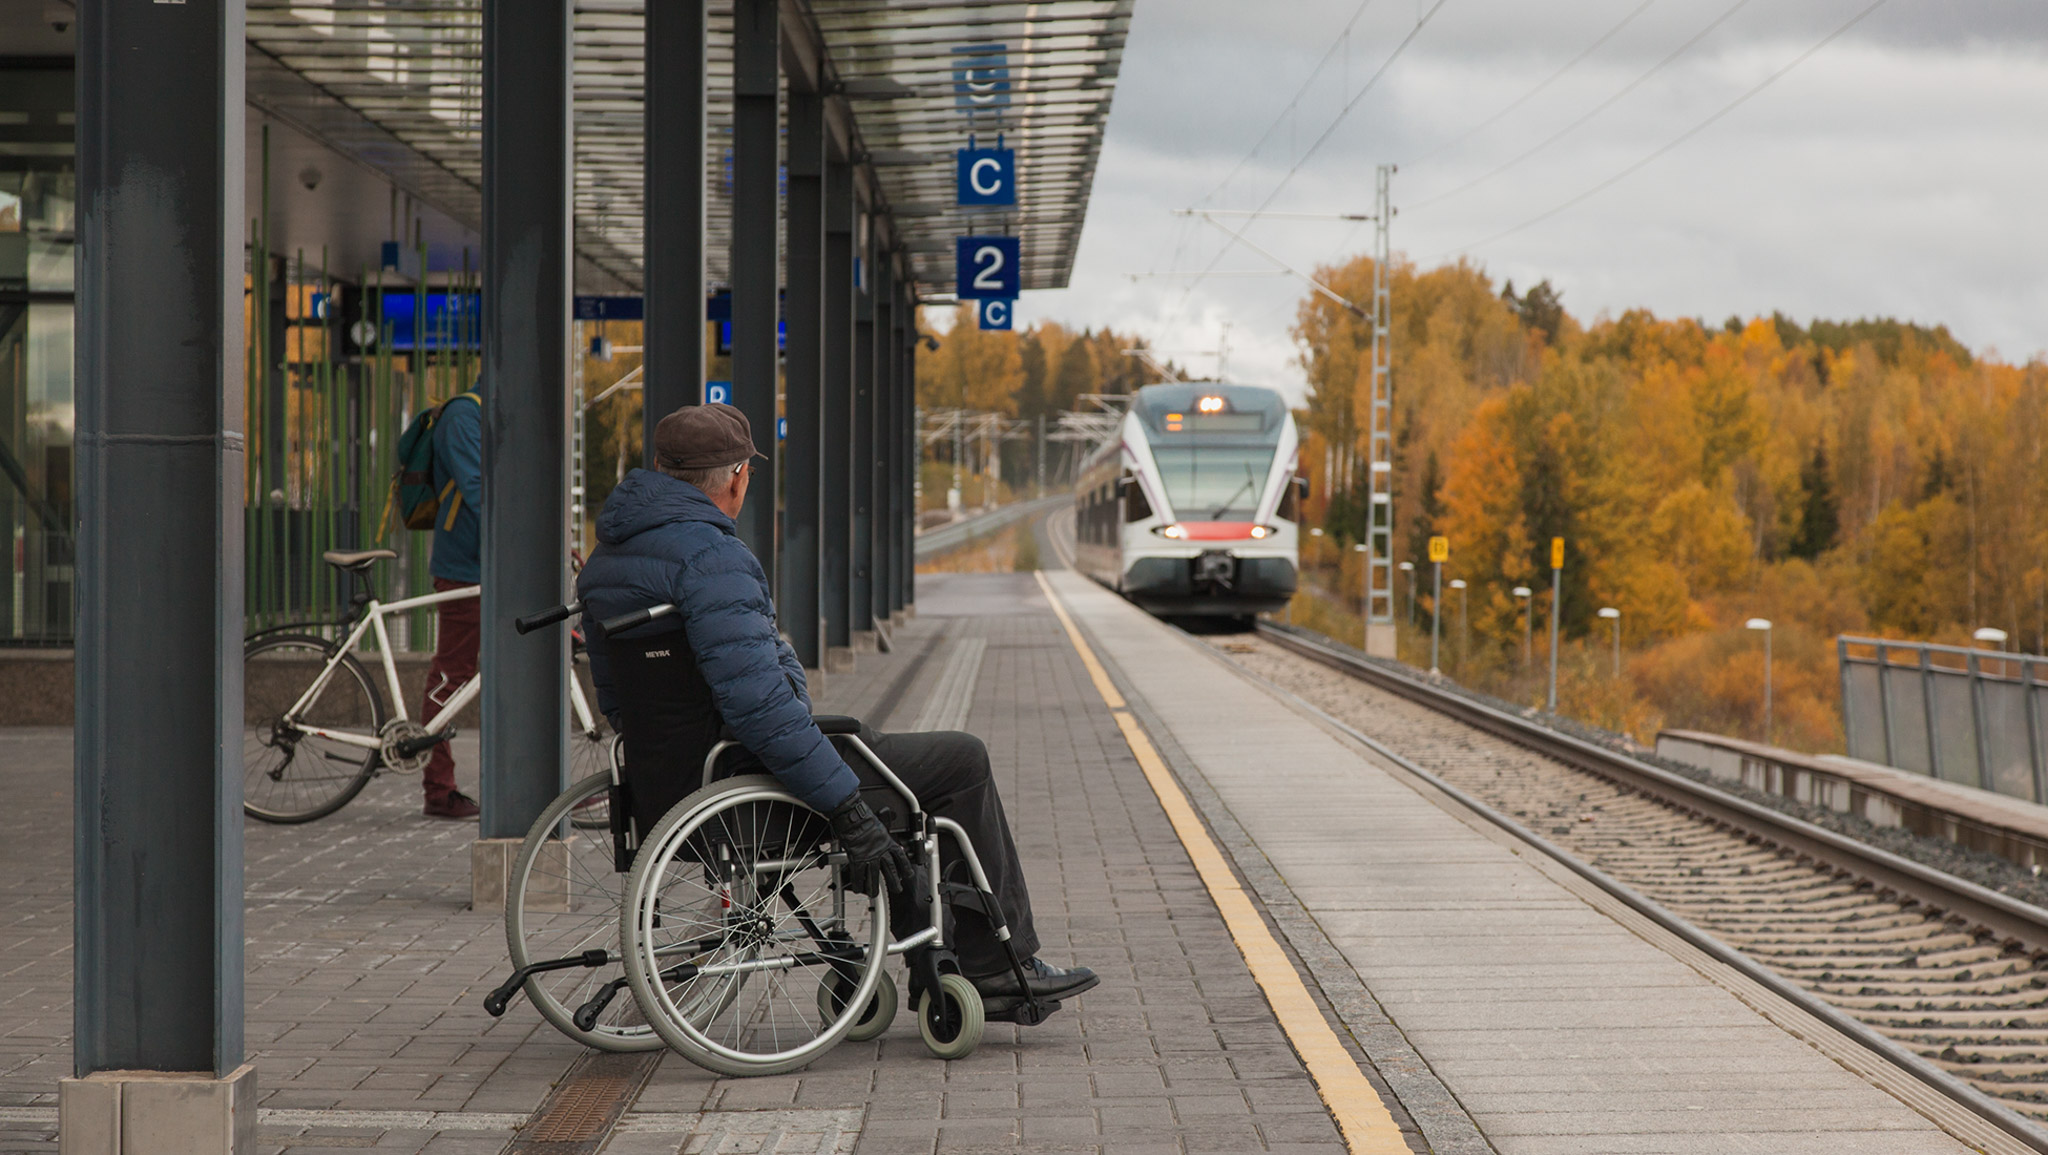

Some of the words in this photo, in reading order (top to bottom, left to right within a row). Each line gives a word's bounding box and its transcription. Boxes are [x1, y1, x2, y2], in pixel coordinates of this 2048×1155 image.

[970, 158, 1002, 196] C
[972, 245, 1004, 289] 2
[985, 301, 1007, 326] C
[645, 649, 671, 659] MEYRA
